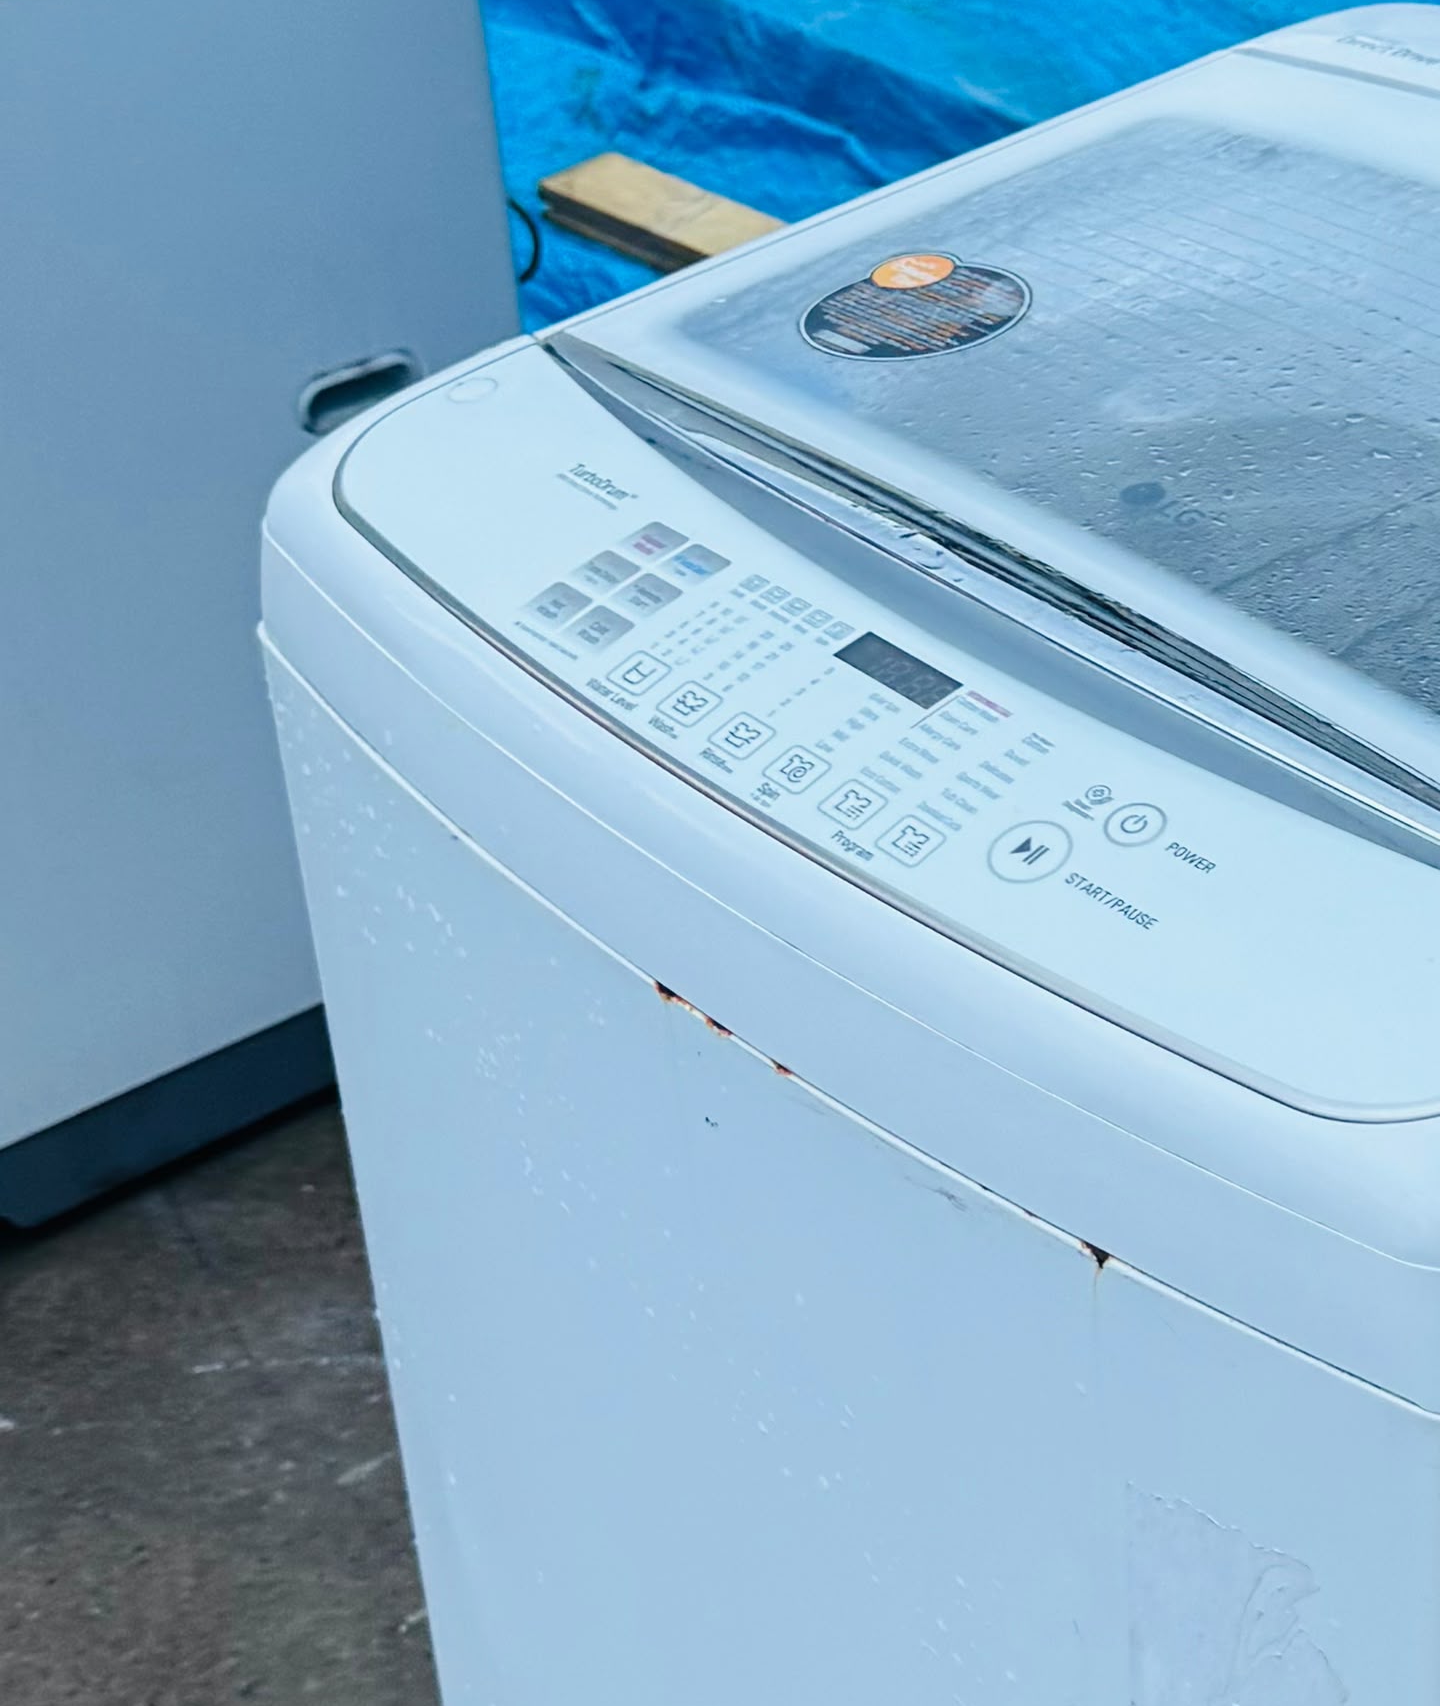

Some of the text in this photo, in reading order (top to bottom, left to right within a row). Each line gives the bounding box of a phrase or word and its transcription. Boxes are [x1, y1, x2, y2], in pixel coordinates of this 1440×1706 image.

[831, 830, 874, 861] Program
[1165, 842, 1217, 874] POWER
[1064, 872, 1159, 930] START/PAUSE
